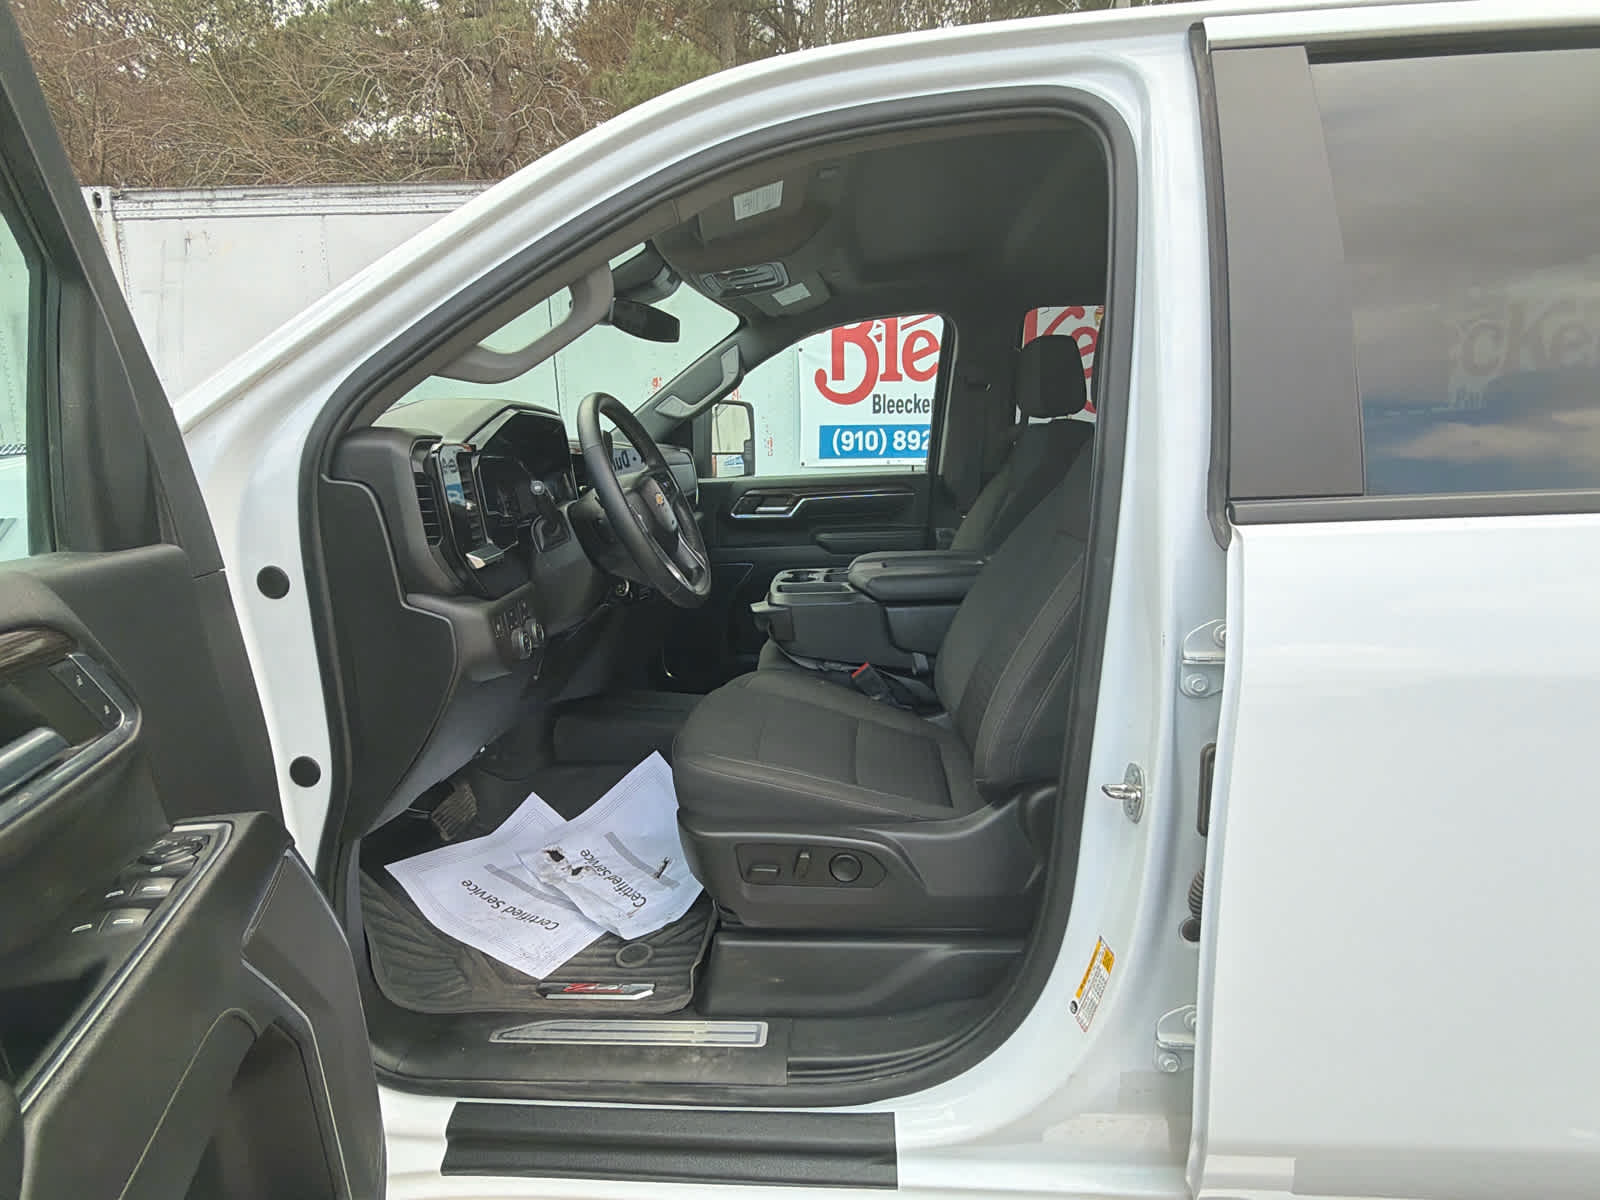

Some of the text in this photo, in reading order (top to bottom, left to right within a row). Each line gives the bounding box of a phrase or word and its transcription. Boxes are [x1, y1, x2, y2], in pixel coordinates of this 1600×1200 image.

[832, 427, 930, 456] (910) 892
[580, 849, 647, 908] Certified Service
[461, 879, 560, 931] Certified Service
